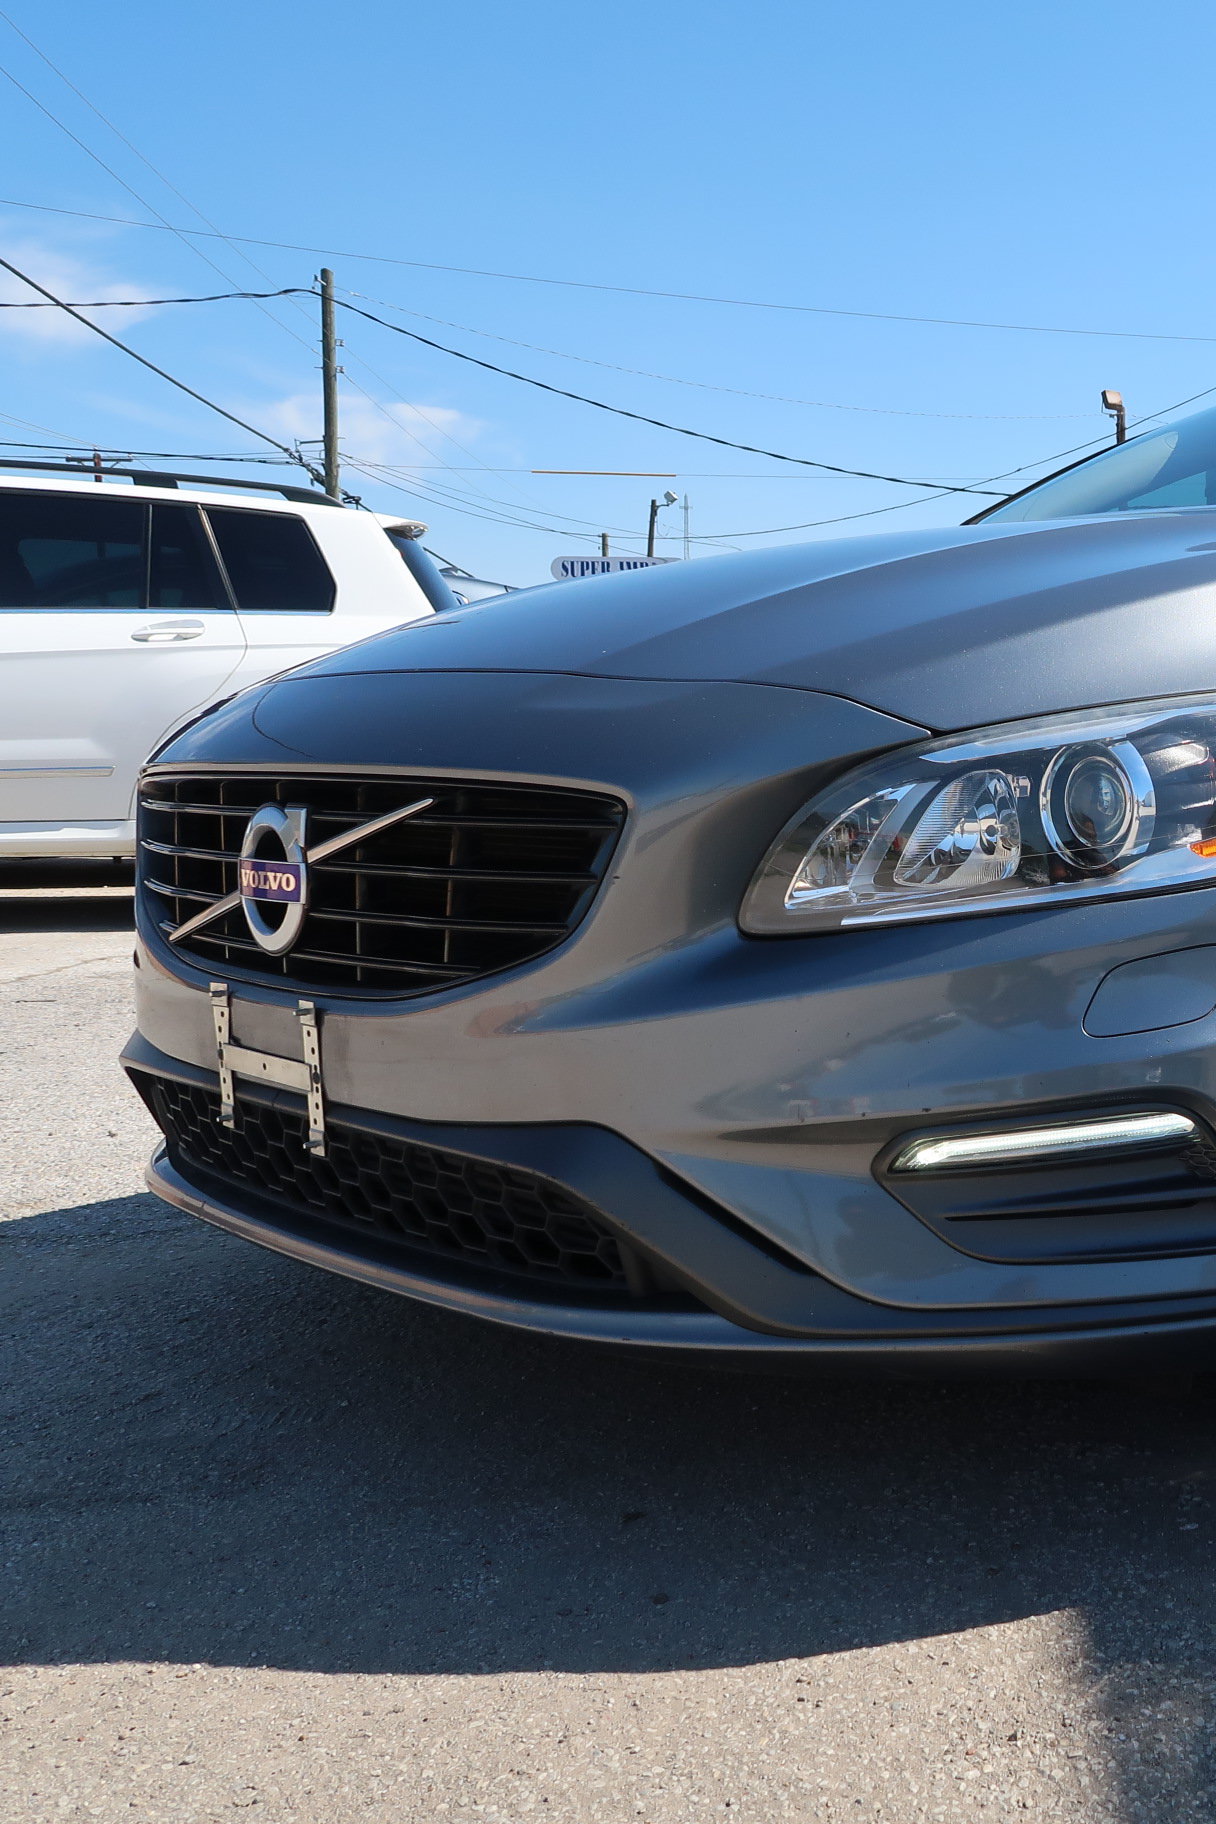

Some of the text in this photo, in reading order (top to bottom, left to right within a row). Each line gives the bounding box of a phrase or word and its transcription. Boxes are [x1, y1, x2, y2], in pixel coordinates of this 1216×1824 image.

[560, 560, 657, 578] SUPER IM
[241, 868, 297, 892] VOLVO
